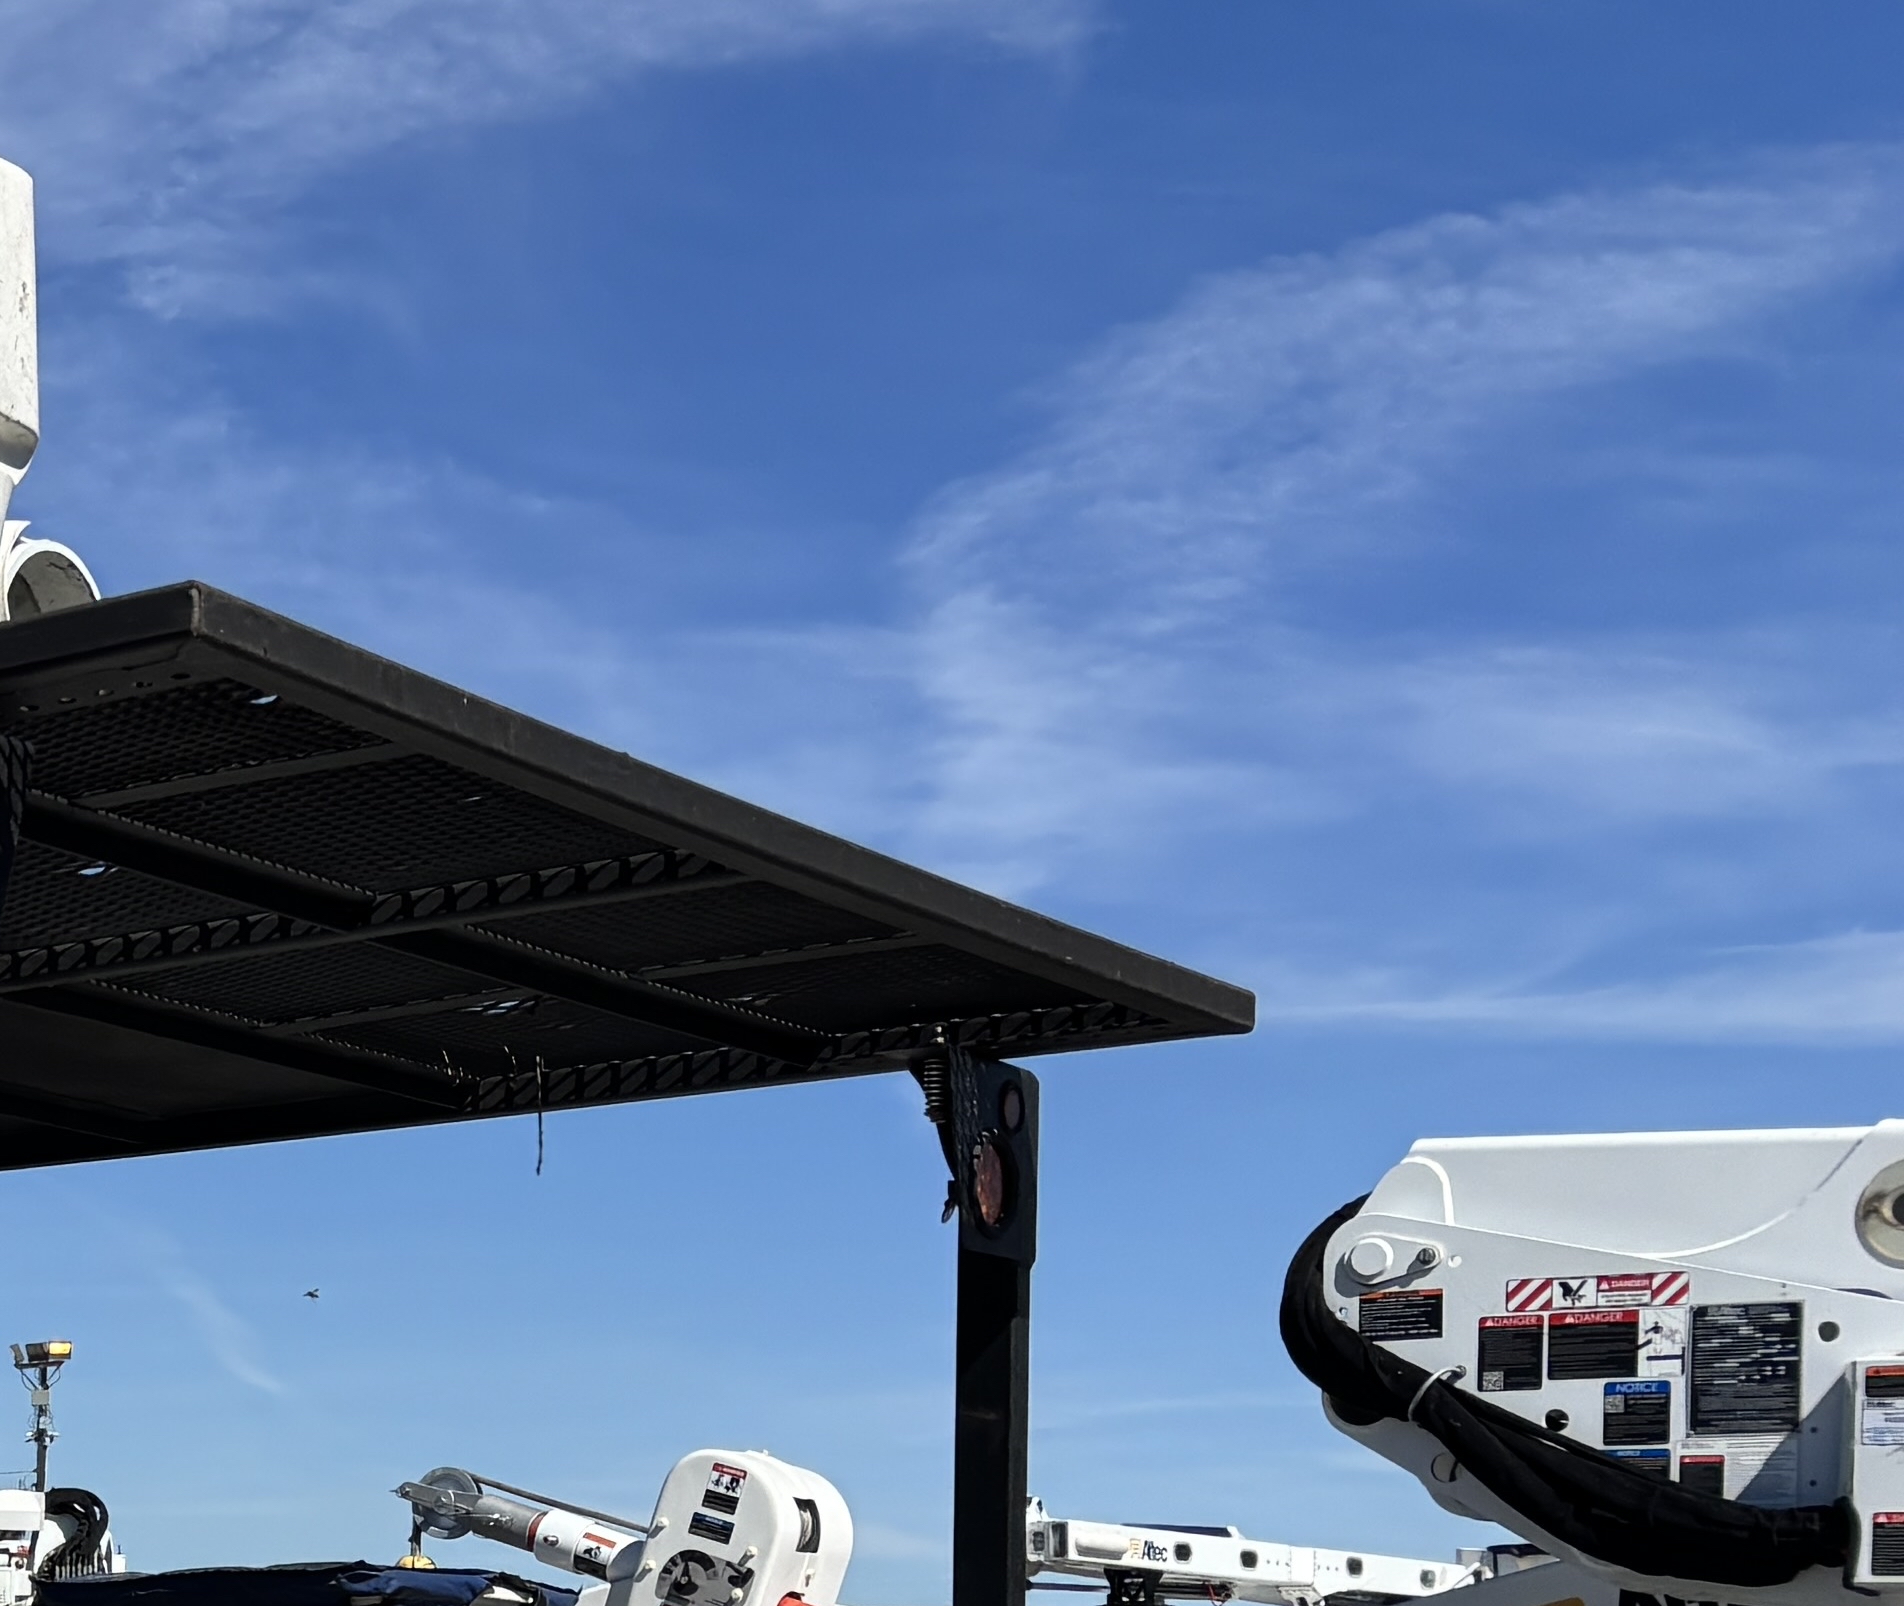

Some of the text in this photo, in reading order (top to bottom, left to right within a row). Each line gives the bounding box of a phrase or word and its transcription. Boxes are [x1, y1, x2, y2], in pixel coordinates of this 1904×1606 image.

[1493, 1317, 1538, 1327] DANGER
[1573, 1312, 1624, 1324] DANGER
[1615, 1382, 1659, 1393] NOTICE
